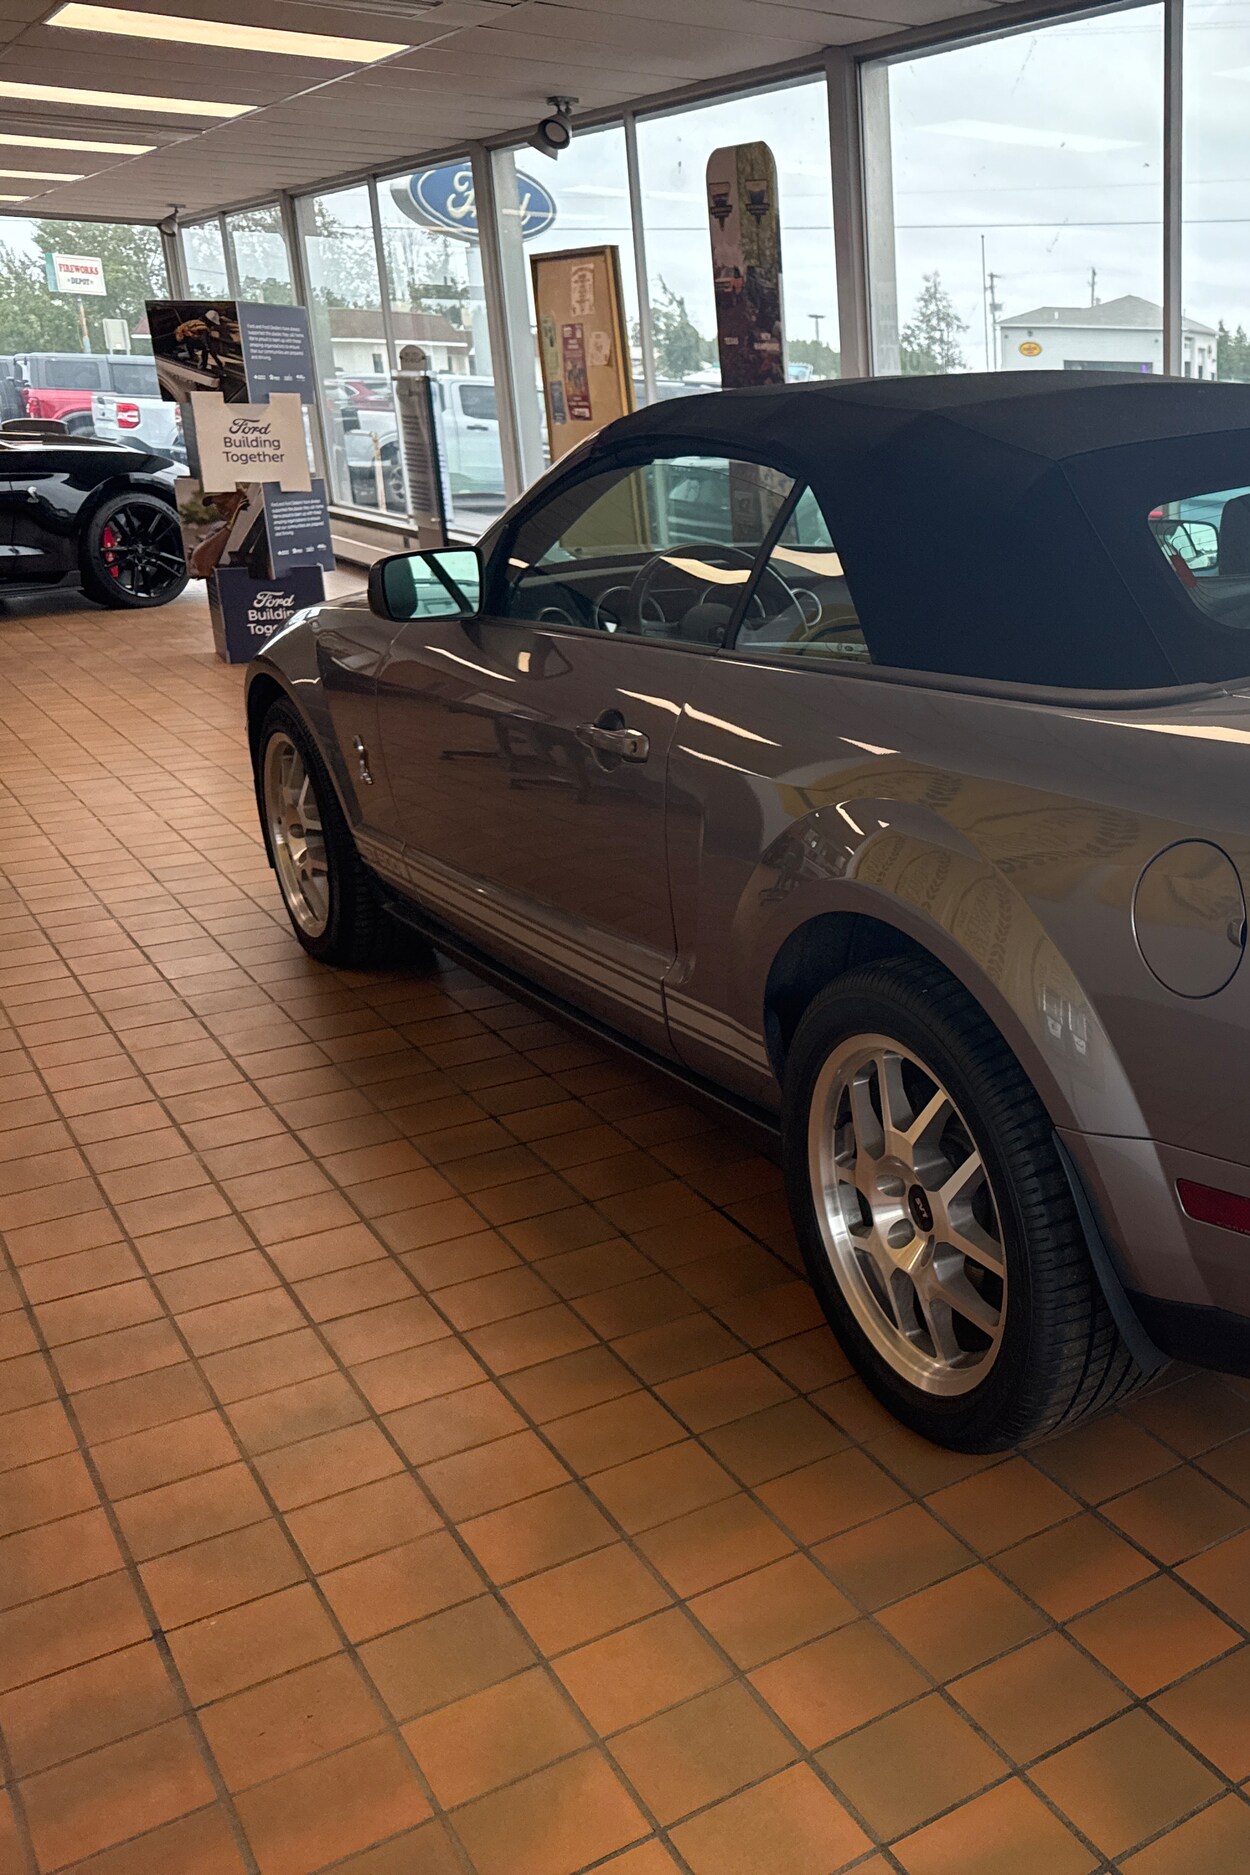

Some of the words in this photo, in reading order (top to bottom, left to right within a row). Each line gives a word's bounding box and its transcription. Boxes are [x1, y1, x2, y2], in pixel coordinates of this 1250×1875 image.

[58, 264, 99, 275] FIREWORKS
[71, 277, 90, 286] DEPOT
[229, 418, 271, 435] Ford
[223, 436, 281, 450] Building
[222, 451, 285, 465] Together
[253, 591, 295, 608] Ford
[247, 608, 295, 621] Buildin
